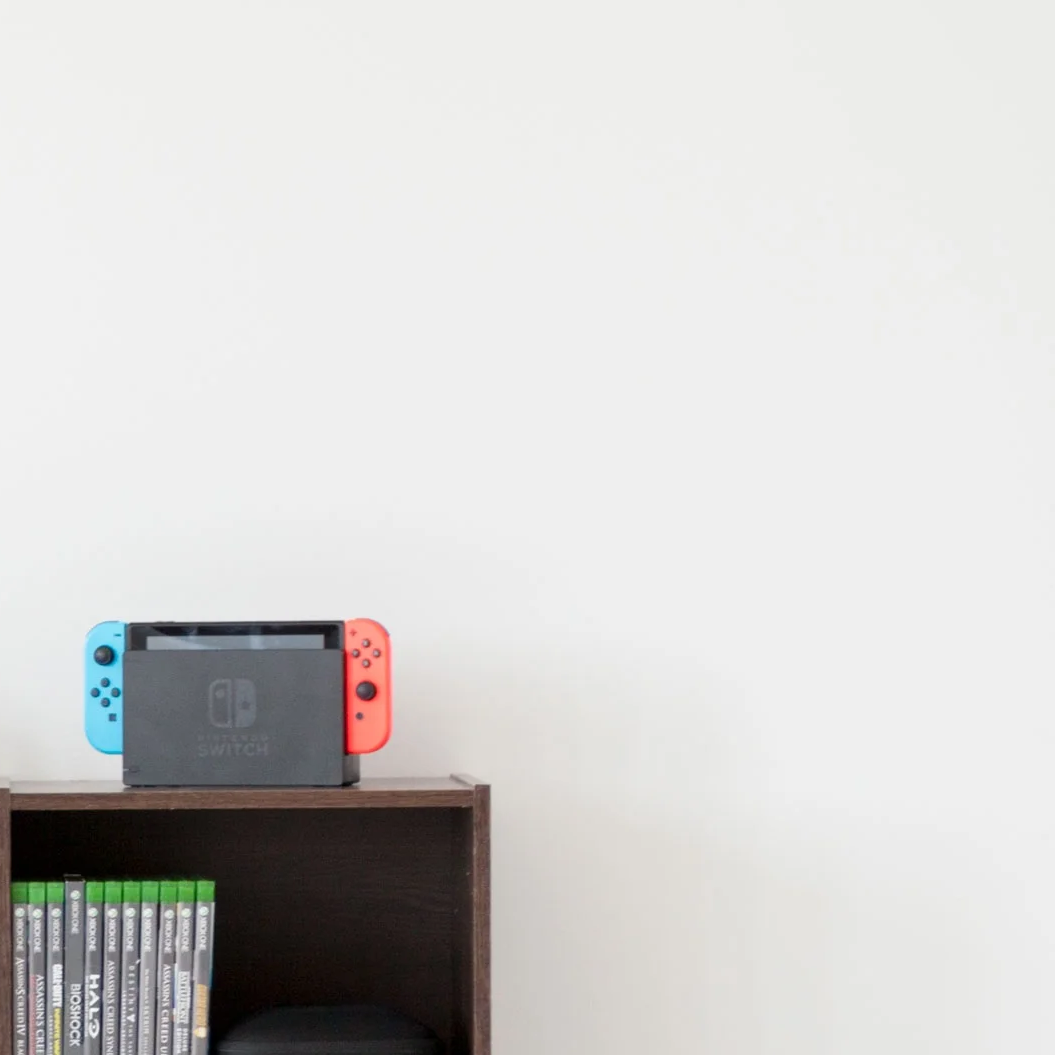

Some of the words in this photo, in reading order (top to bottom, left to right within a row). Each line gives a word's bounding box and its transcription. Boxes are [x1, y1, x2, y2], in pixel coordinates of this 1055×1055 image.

[197, 743, 269, 756] SWITCH
[71, 901, 80, 919] XBOX
[15, 918, 24, 936] XBOX
[33, 919, 42, 938] XBOX
[52, 918, 61, 936] XBOX
[88, 917, 97, 935] XBOX
[108, 918, 117, 936] XBOX
[125, 917, 135, 936] XBOX
[143, 918, 153, 936] XBOX
[163, 919, 173, 938] XBOX
[181, 918, 191, 936] XBOX
[199, 917, 209, 935] XBOX
[128, 965, 136, 1012] DESTINY
[16, 996, 25, 1023] CREED
[68, 983, 82, 1047] BIOSHOCK
[88, 973, 101, 1039] HALO
[15, 1025, 26, 1036] IV
[106, 1008, 115, 1035] CREED
[160, 1009, 171, 1042] CREED
